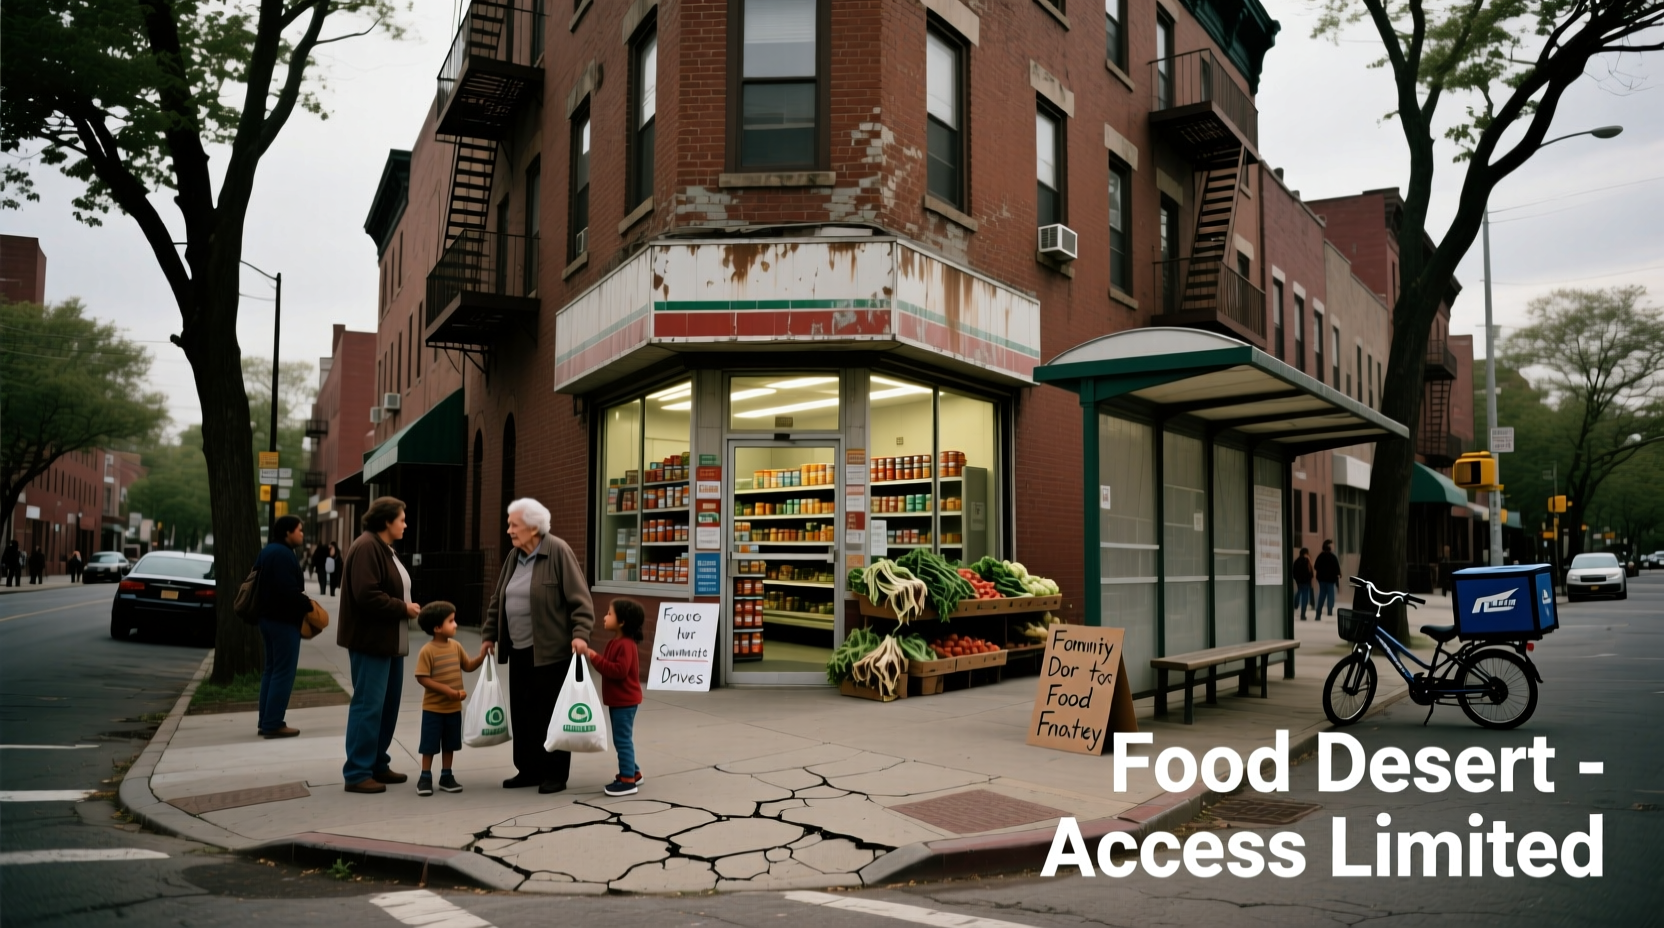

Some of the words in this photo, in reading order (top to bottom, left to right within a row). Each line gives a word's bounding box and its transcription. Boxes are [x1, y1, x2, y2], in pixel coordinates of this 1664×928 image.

[661, 666, 704, 685] Drives
[1048, 656, 1079, 678] Dor
[1046, 684, 1094, 709] Food
